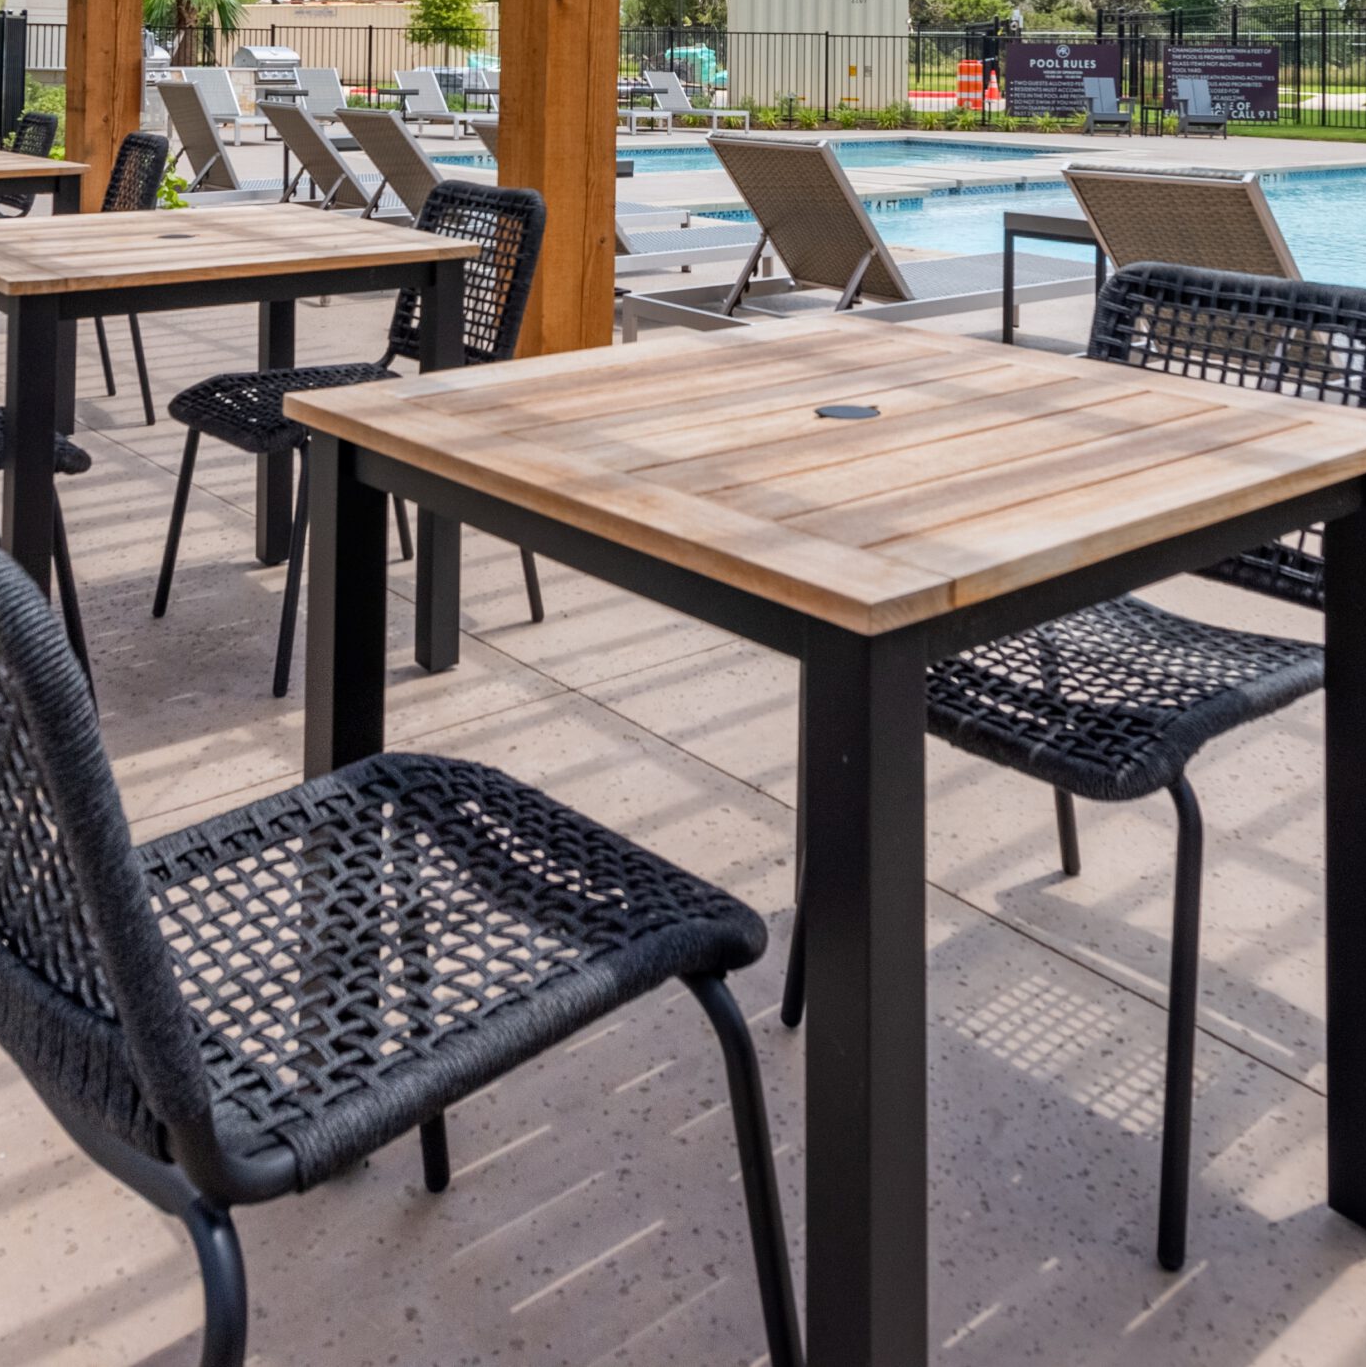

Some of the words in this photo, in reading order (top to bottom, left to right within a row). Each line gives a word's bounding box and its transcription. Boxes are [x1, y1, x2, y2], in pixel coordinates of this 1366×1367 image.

[1029, 59, 1060, 68] POOL
[1063, 59, 1097, 68] RULES
[1237, 102, 1251, 111] OF
[1231, 111, 1255, 119] CALL
[1258, 111, 1277, 119] 911
